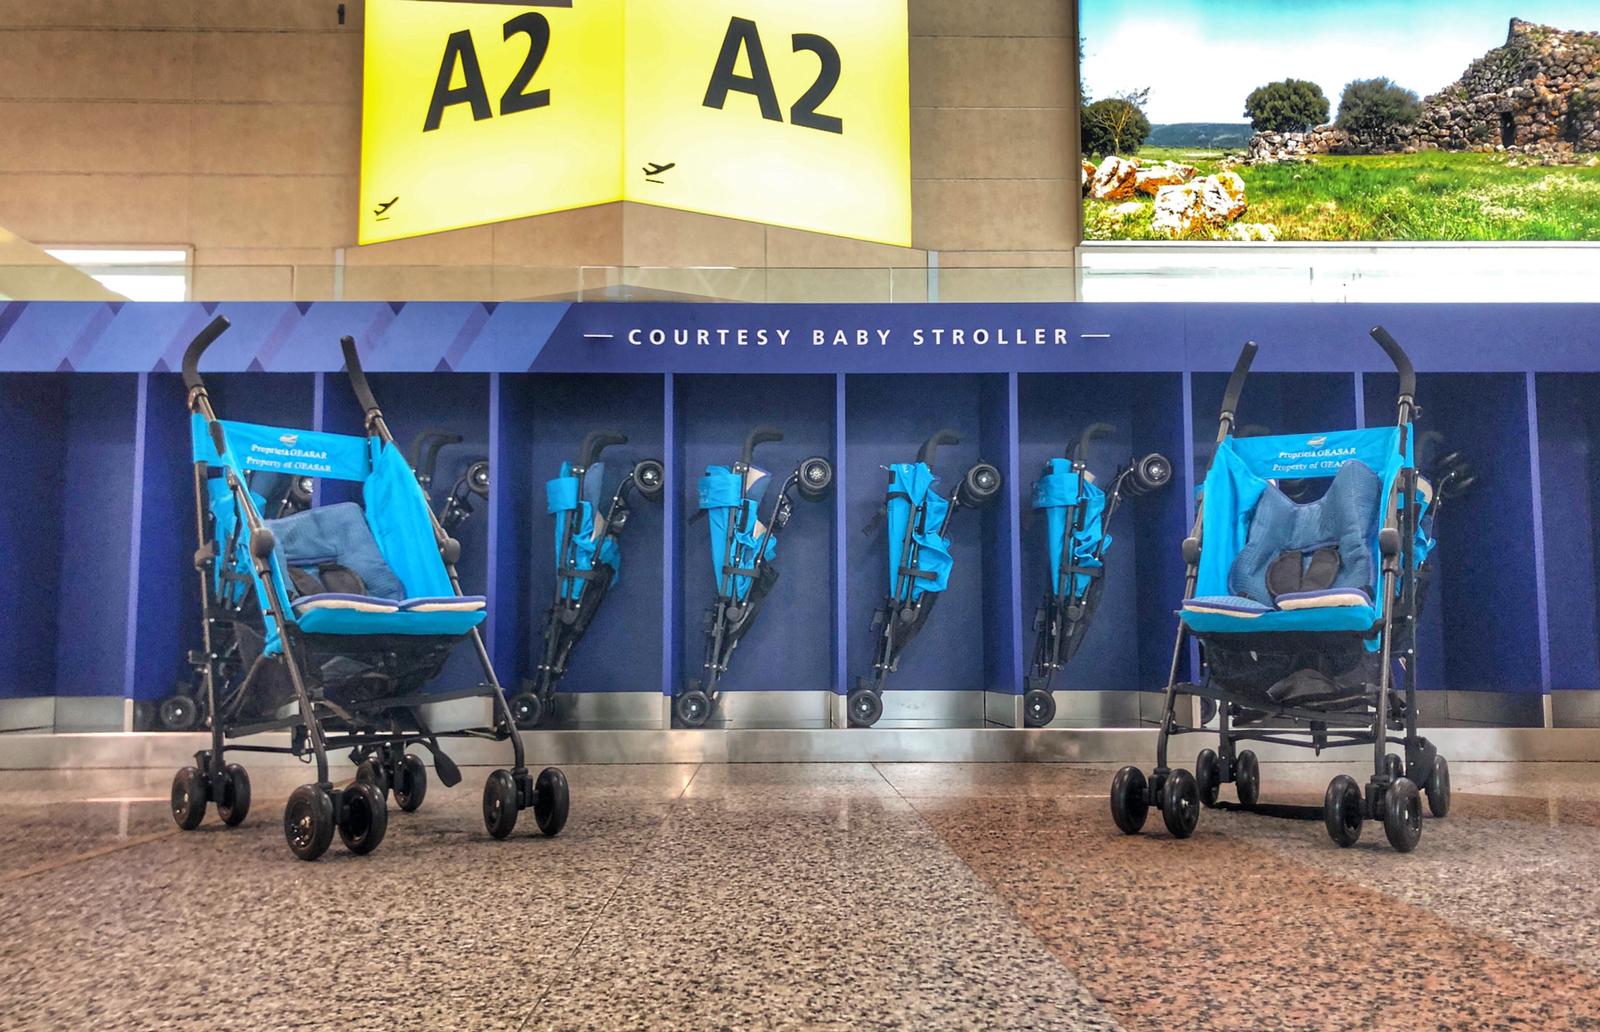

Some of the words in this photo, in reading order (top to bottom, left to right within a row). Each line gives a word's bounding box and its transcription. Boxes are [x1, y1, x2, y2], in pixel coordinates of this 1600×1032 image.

[423, 12, 551, 132] A2
[703, 17, 843, 134] A2
[628, 328, 790, 346] COURTESY
[813, 328, 891, 346] BABY
[913, 328, 1068, 346] STROLLER
[290, 449, 327, 459] GEASAR
[1317, 447, 1356, 457] GEASAR
[246, 456, 281, 467] Property
[295, 462, 331, 472] GEASAR
[1272, 463, 1307, 472] Property
[1309, 461, 1318, 469] of
[1320, 460, 1346, 469] GEAS
